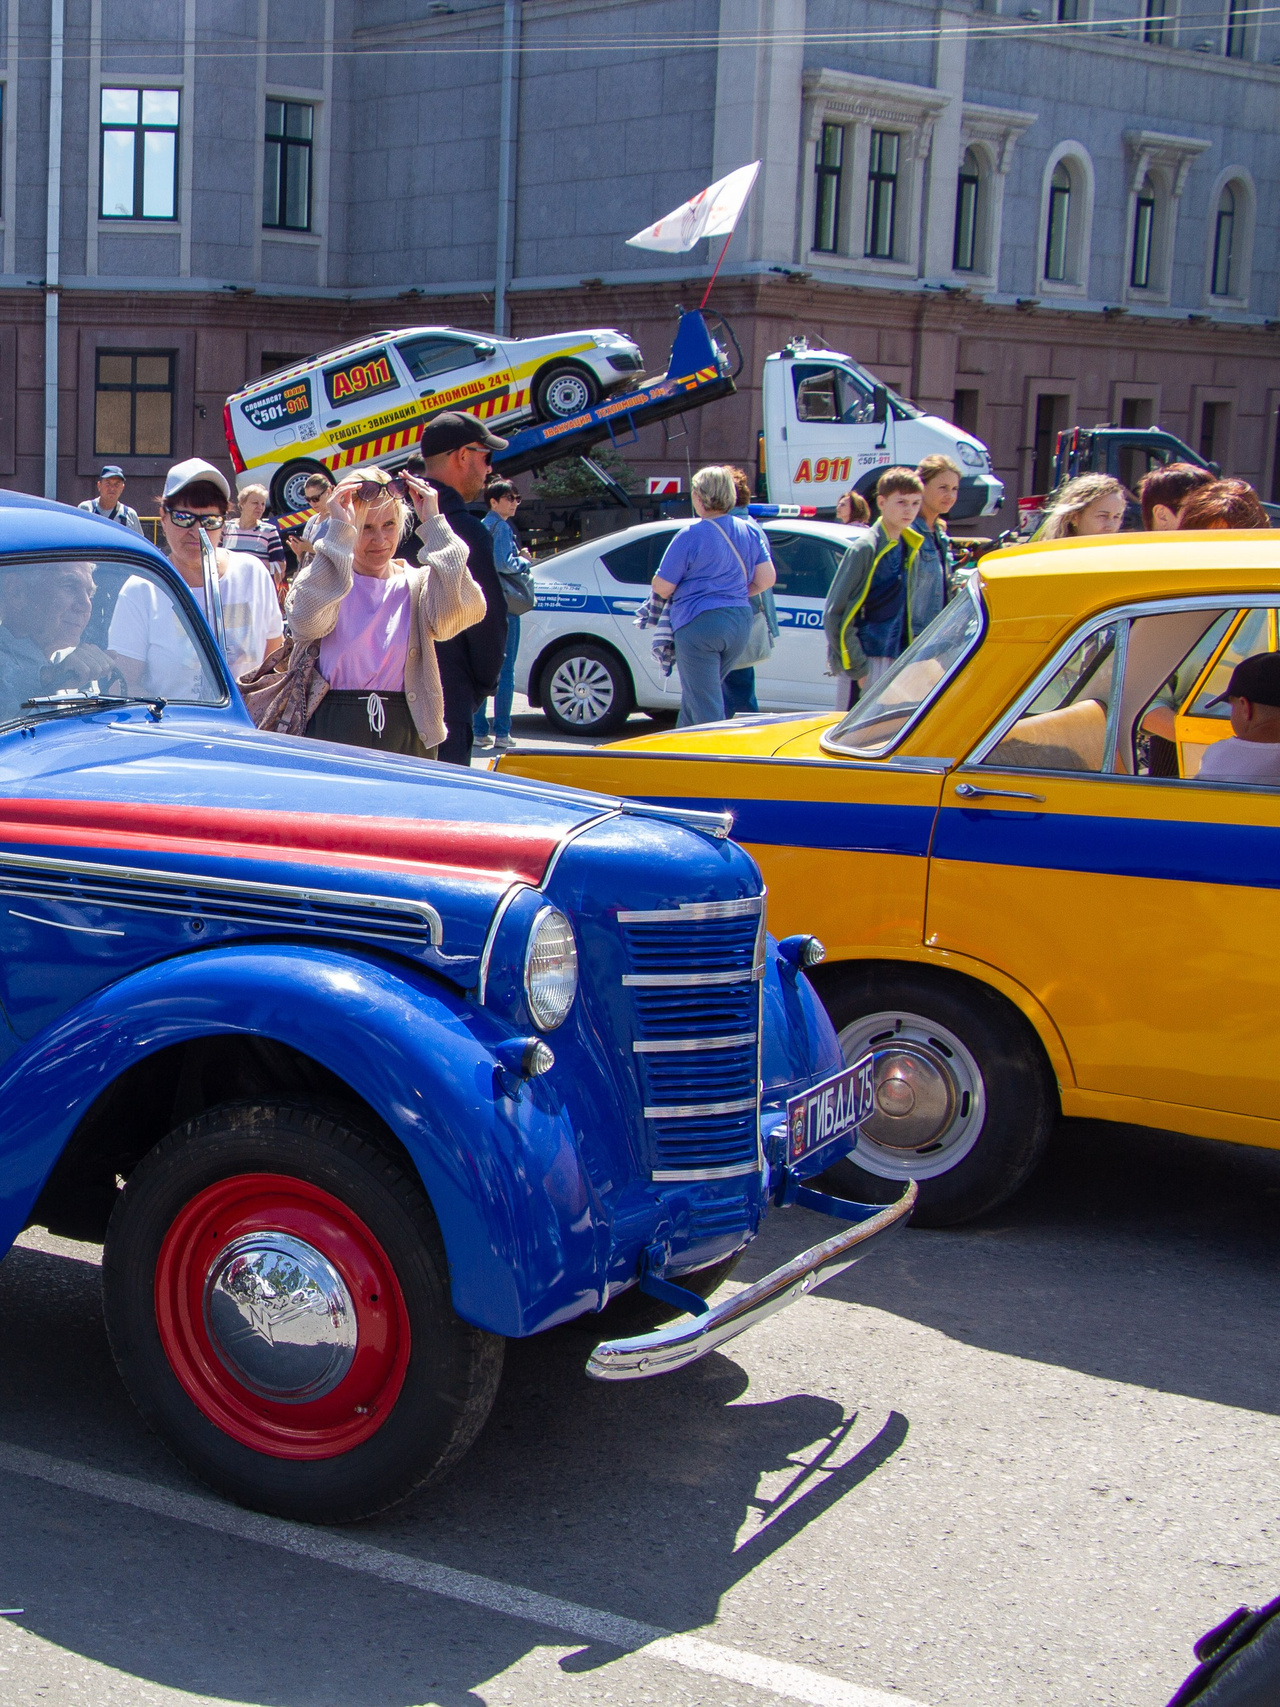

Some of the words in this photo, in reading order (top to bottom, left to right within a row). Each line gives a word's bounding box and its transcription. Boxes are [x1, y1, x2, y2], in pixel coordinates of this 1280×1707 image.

[244, 393, 282, 412] СЛОМАЛСЯ?
[283, 384, 306, 398] ЗВОНИ
[260, 395, 308, 423] 501-911
[329, 424, 362, 443] РЕМОНТ
[367, 405, 417, 429] ЭВАКУАЦИЯ
[421, 381, 486, 411] ТЕХПОМОЩЬ
[543, 413, 593, 439] ЭВАКУАЦИЯ
[595, 393, 649, 419] ТЕХПОМОЩЬ
[863, 456, 890, 465] 501-911
[806, 1077, 856, 1148] ГИБДД
[858, 1063, 873, 1116] 75
